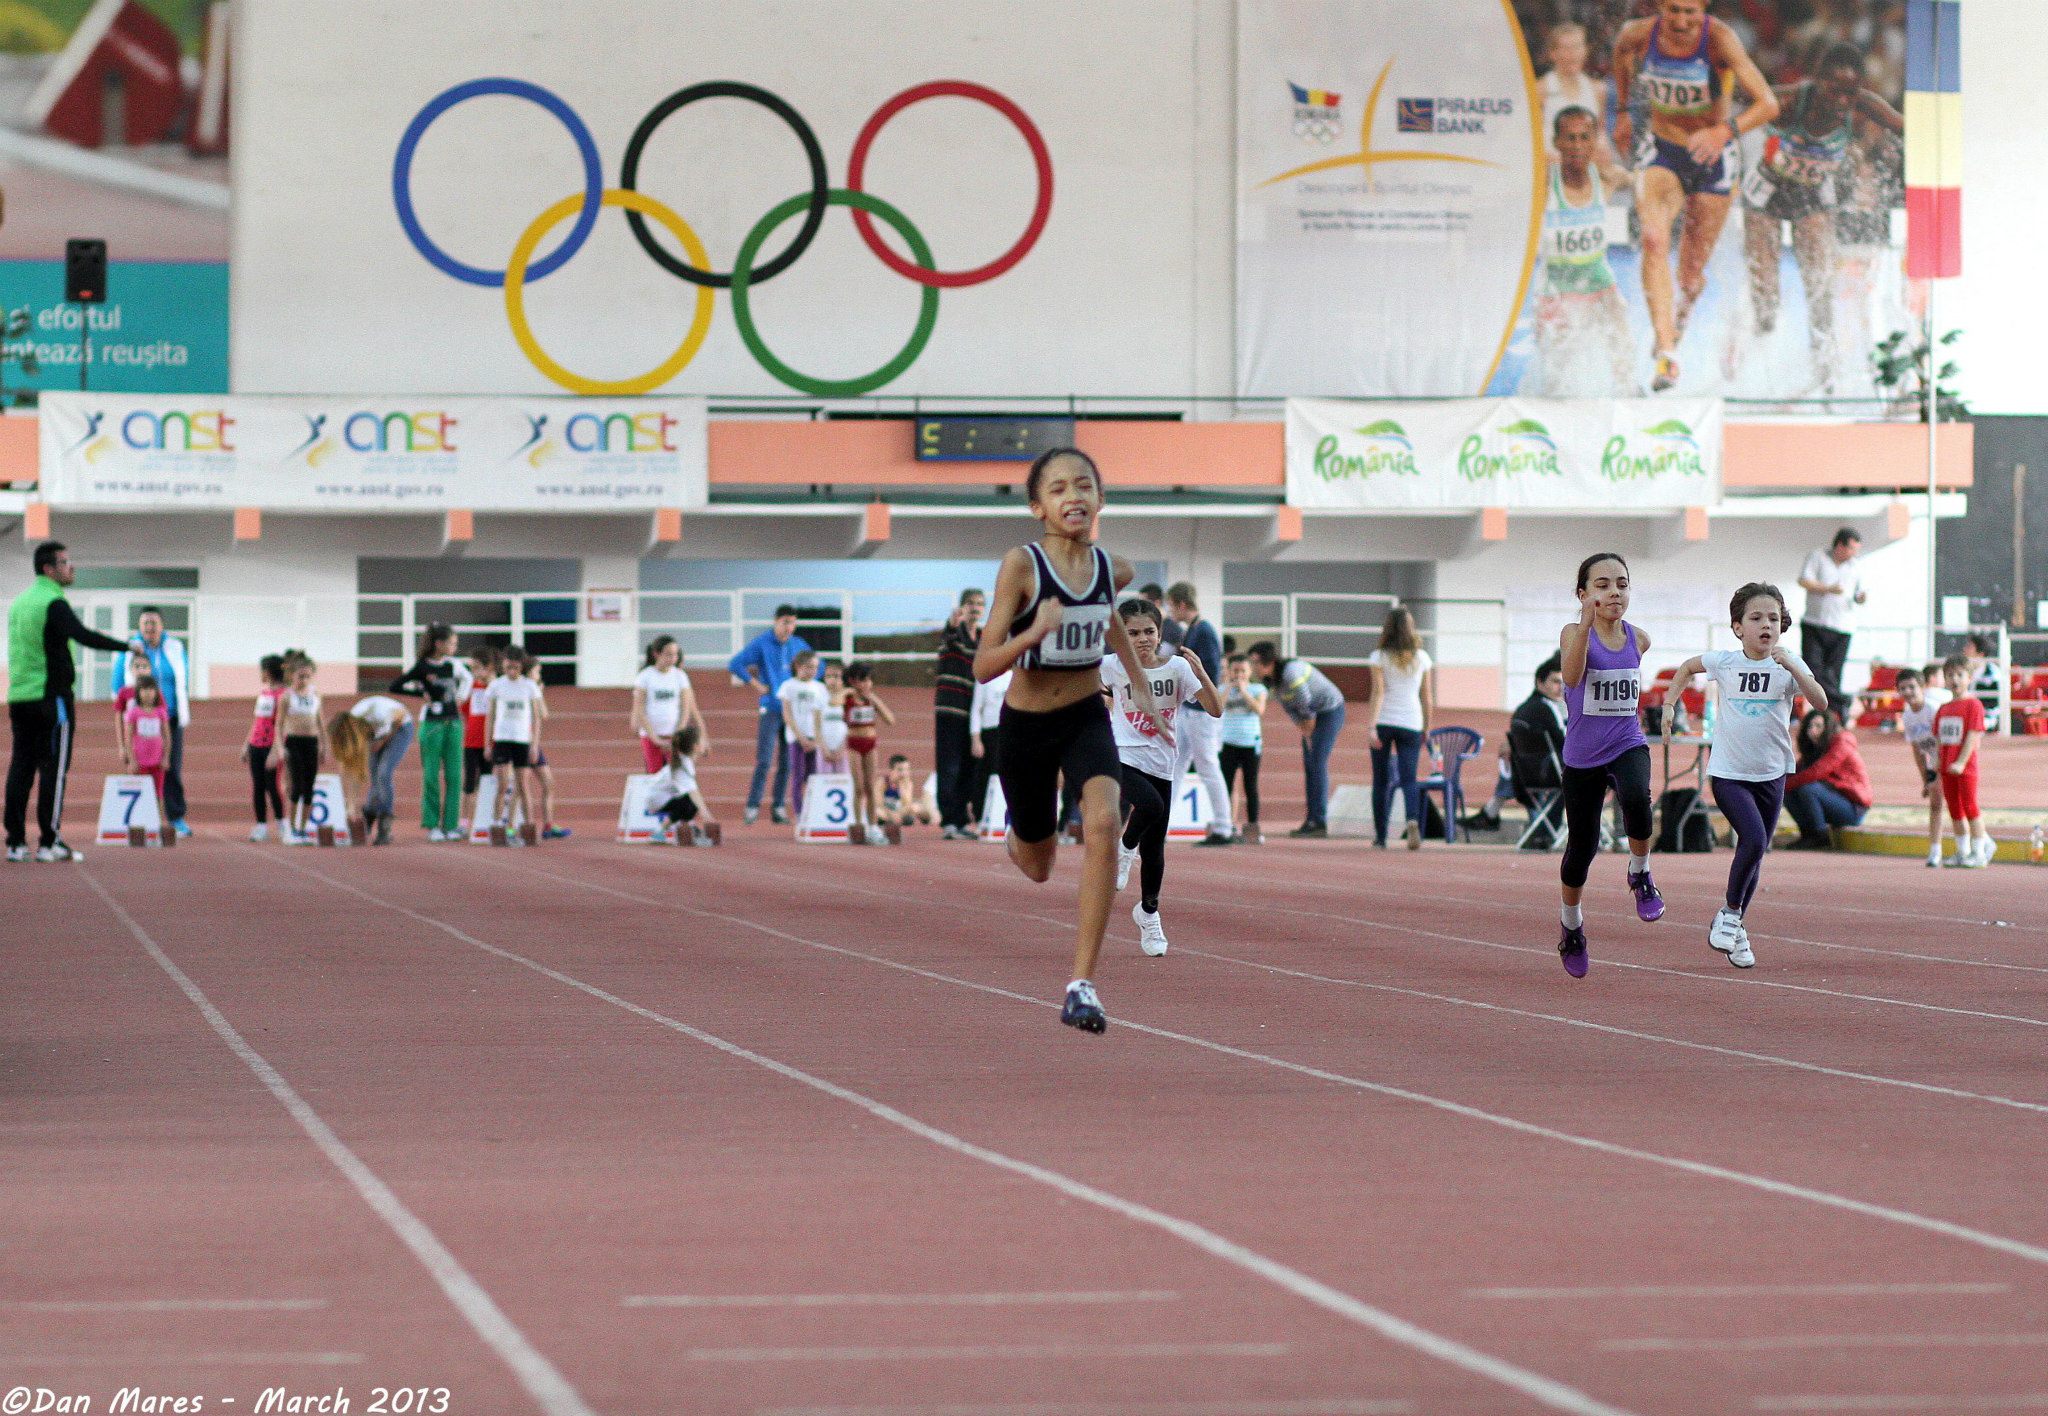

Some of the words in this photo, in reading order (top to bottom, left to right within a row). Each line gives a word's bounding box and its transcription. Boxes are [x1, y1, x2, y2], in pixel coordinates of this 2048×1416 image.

[1438, 98, 1513, 114] PIRAEUS
[1438, 118, 1486, 133] BANK
[1555, 228, 1604, 252] 1669
[103, 340, 189, 369] reușita
[122, 409, 236, 452] anst
[343, 410, 458, 453] anst
[565, 411, 679, 453] anst
[1124, 679, 1174, 700] 190
[1592, 678, 1639, 701] 11196
[1738, 672, 1771, 693] 787
[118, 789, 142, 826] 7
[826, 788, 849, 823] 3
[1182, 787, 1198, 823] 1
